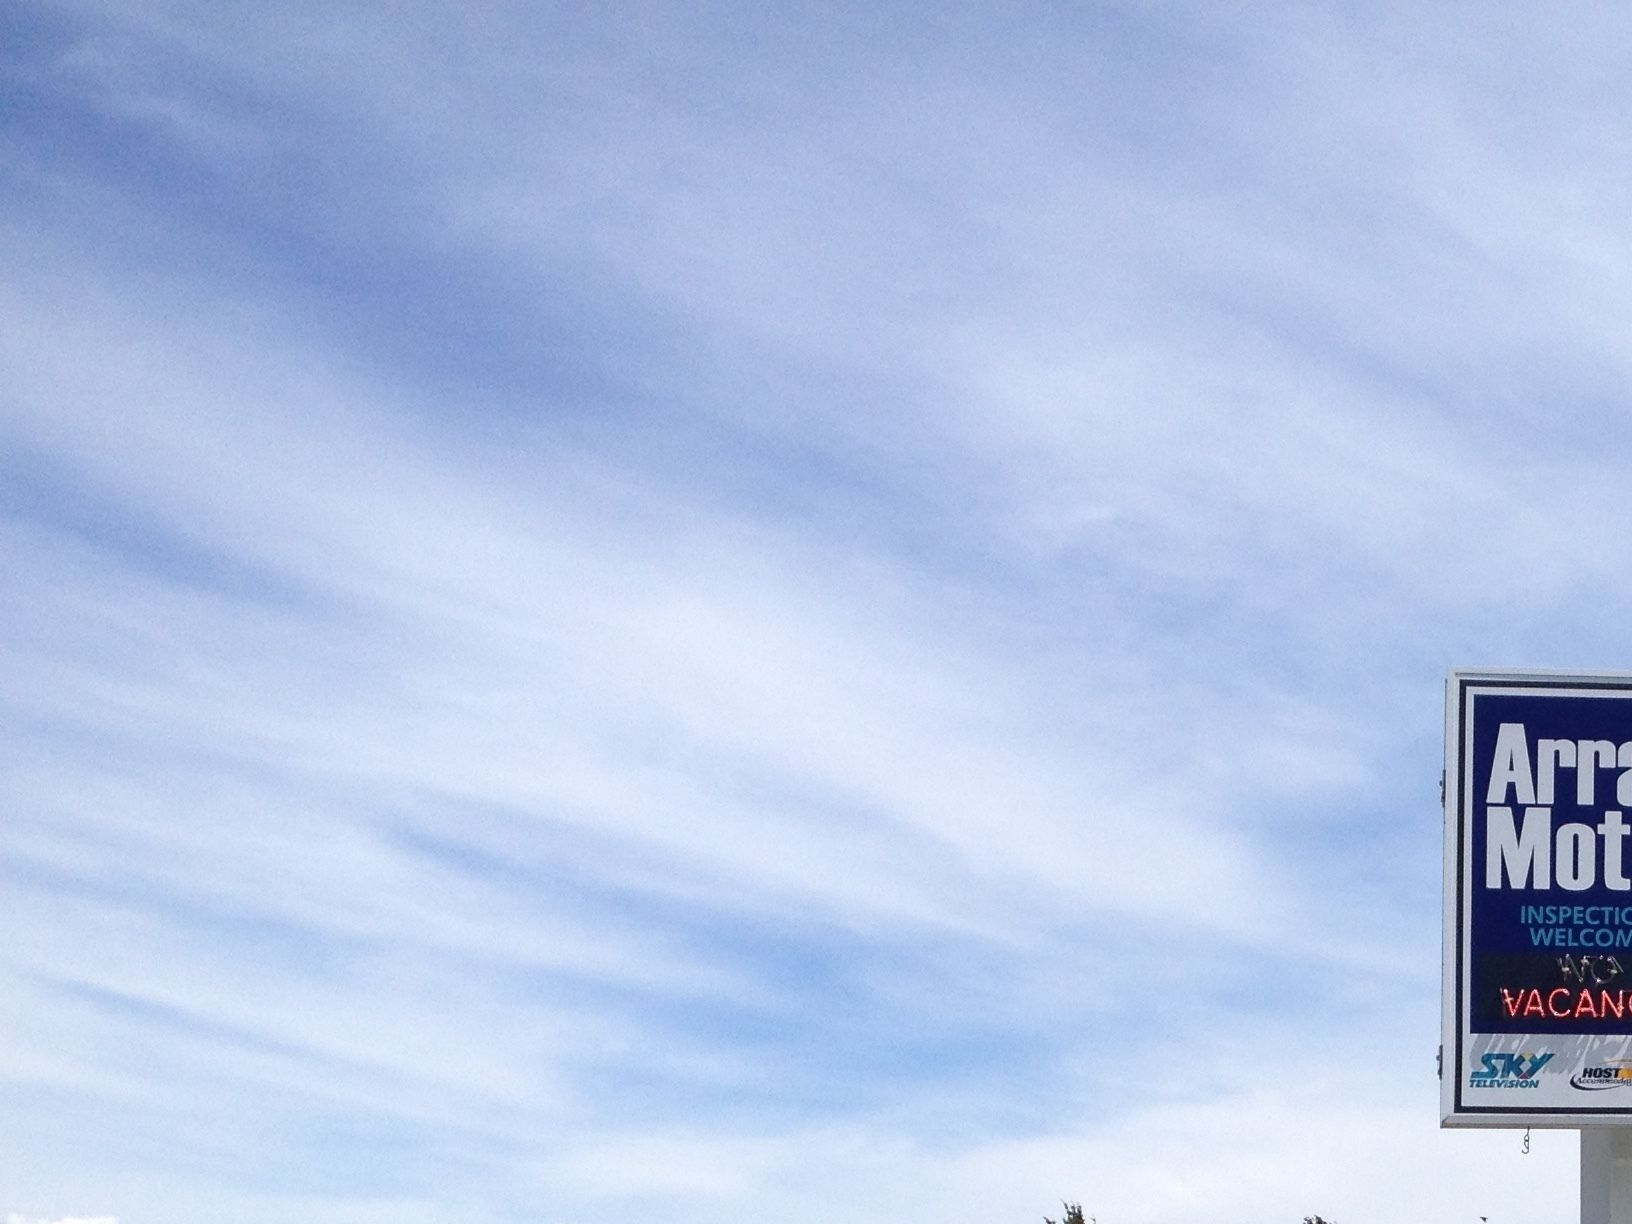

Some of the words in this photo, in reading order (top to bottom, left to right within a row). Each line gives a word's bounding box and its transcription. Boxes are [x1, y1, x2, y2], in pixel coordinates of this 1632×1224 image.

[1470, 1052, 1555, 1080] SKY
[1582, 1067, 1623, 1079] HOST
[1469, 1078, 1540, 1089] TELEVISION
